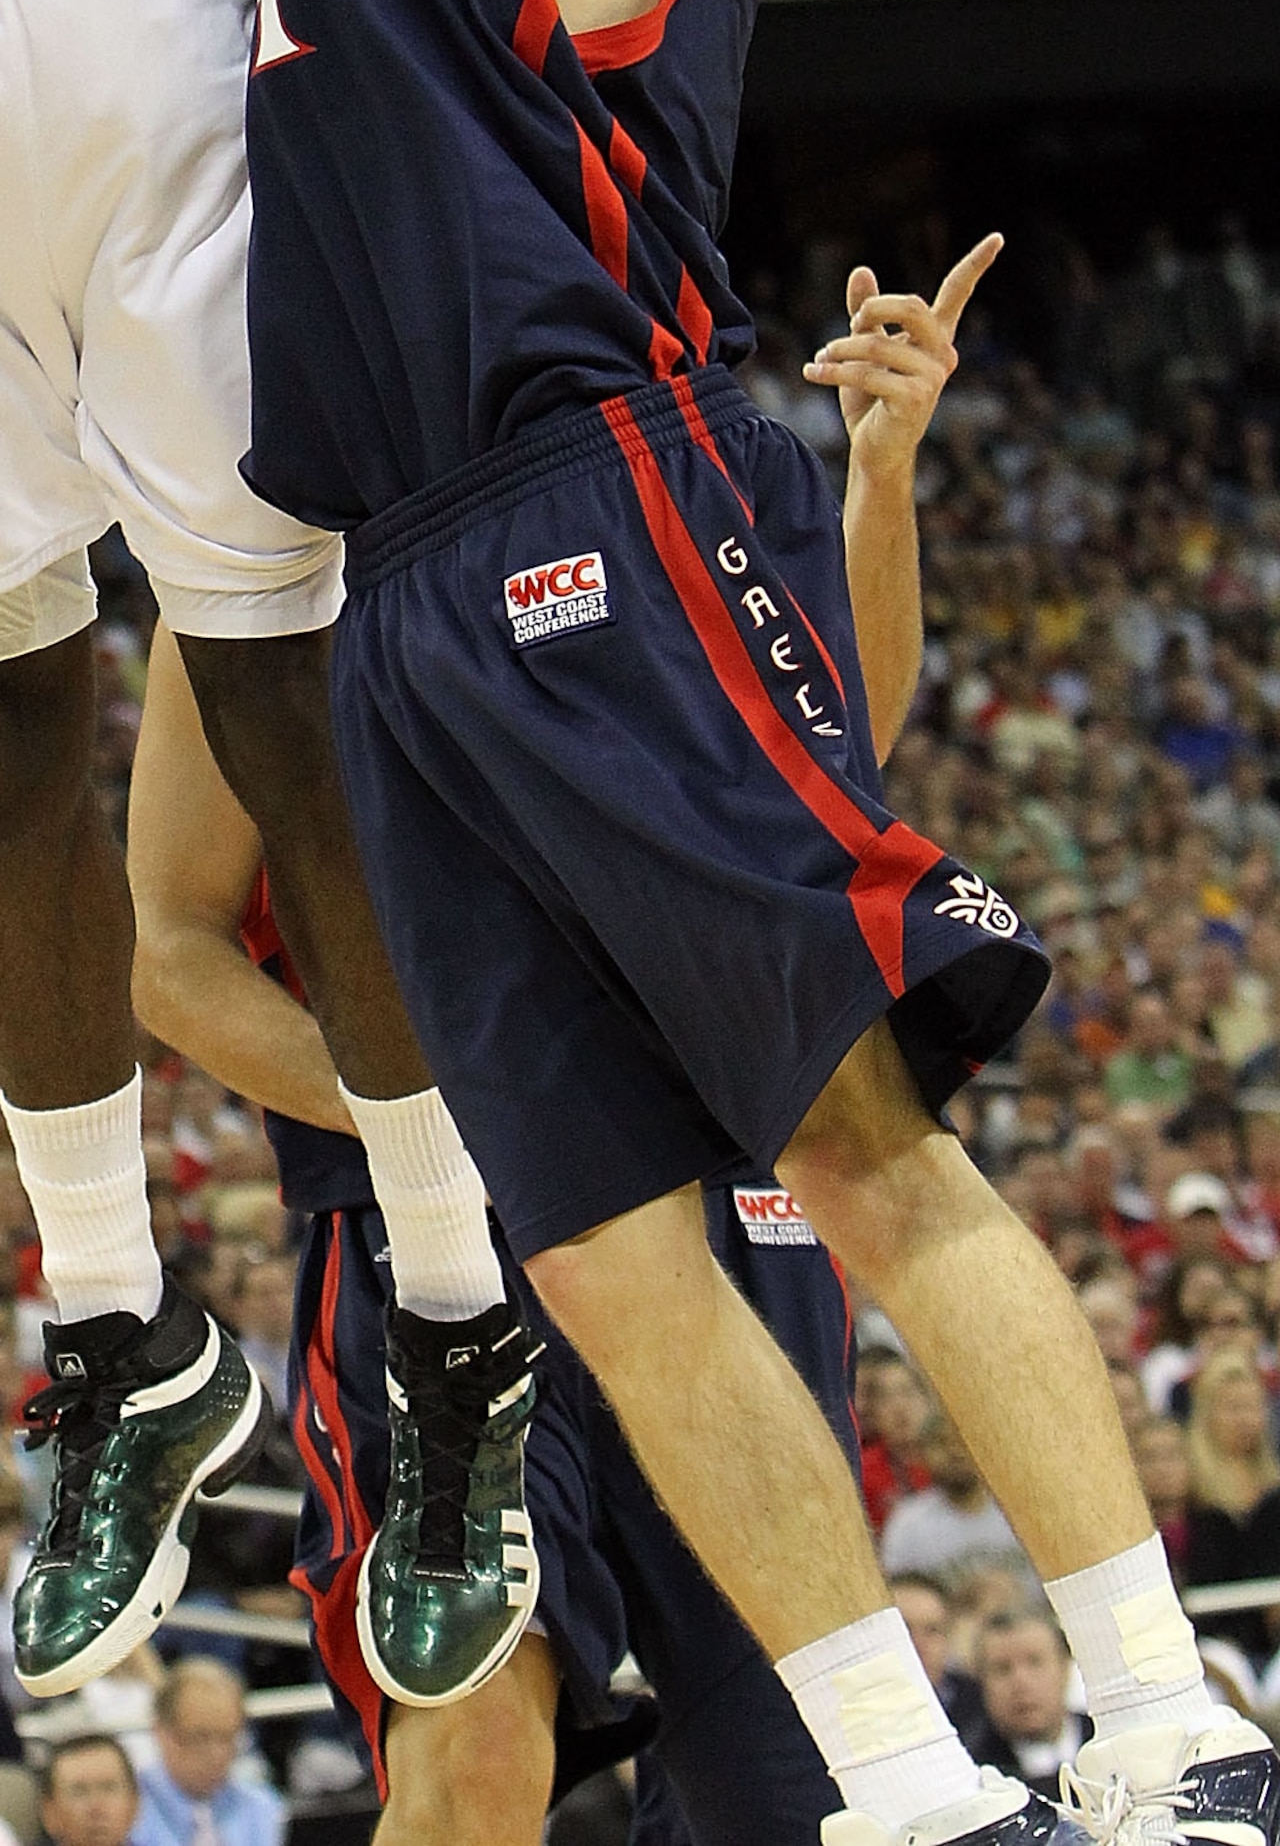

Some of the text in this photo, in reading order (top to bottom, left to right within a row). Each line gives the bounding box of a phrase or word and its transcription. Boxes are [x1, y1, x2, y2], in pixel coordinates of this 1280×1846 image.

[507, 557, 600, 610] WCC
[511, 592, 607, 632] WEST COAST
[513, 605, 610, 644] CONFERENCE
